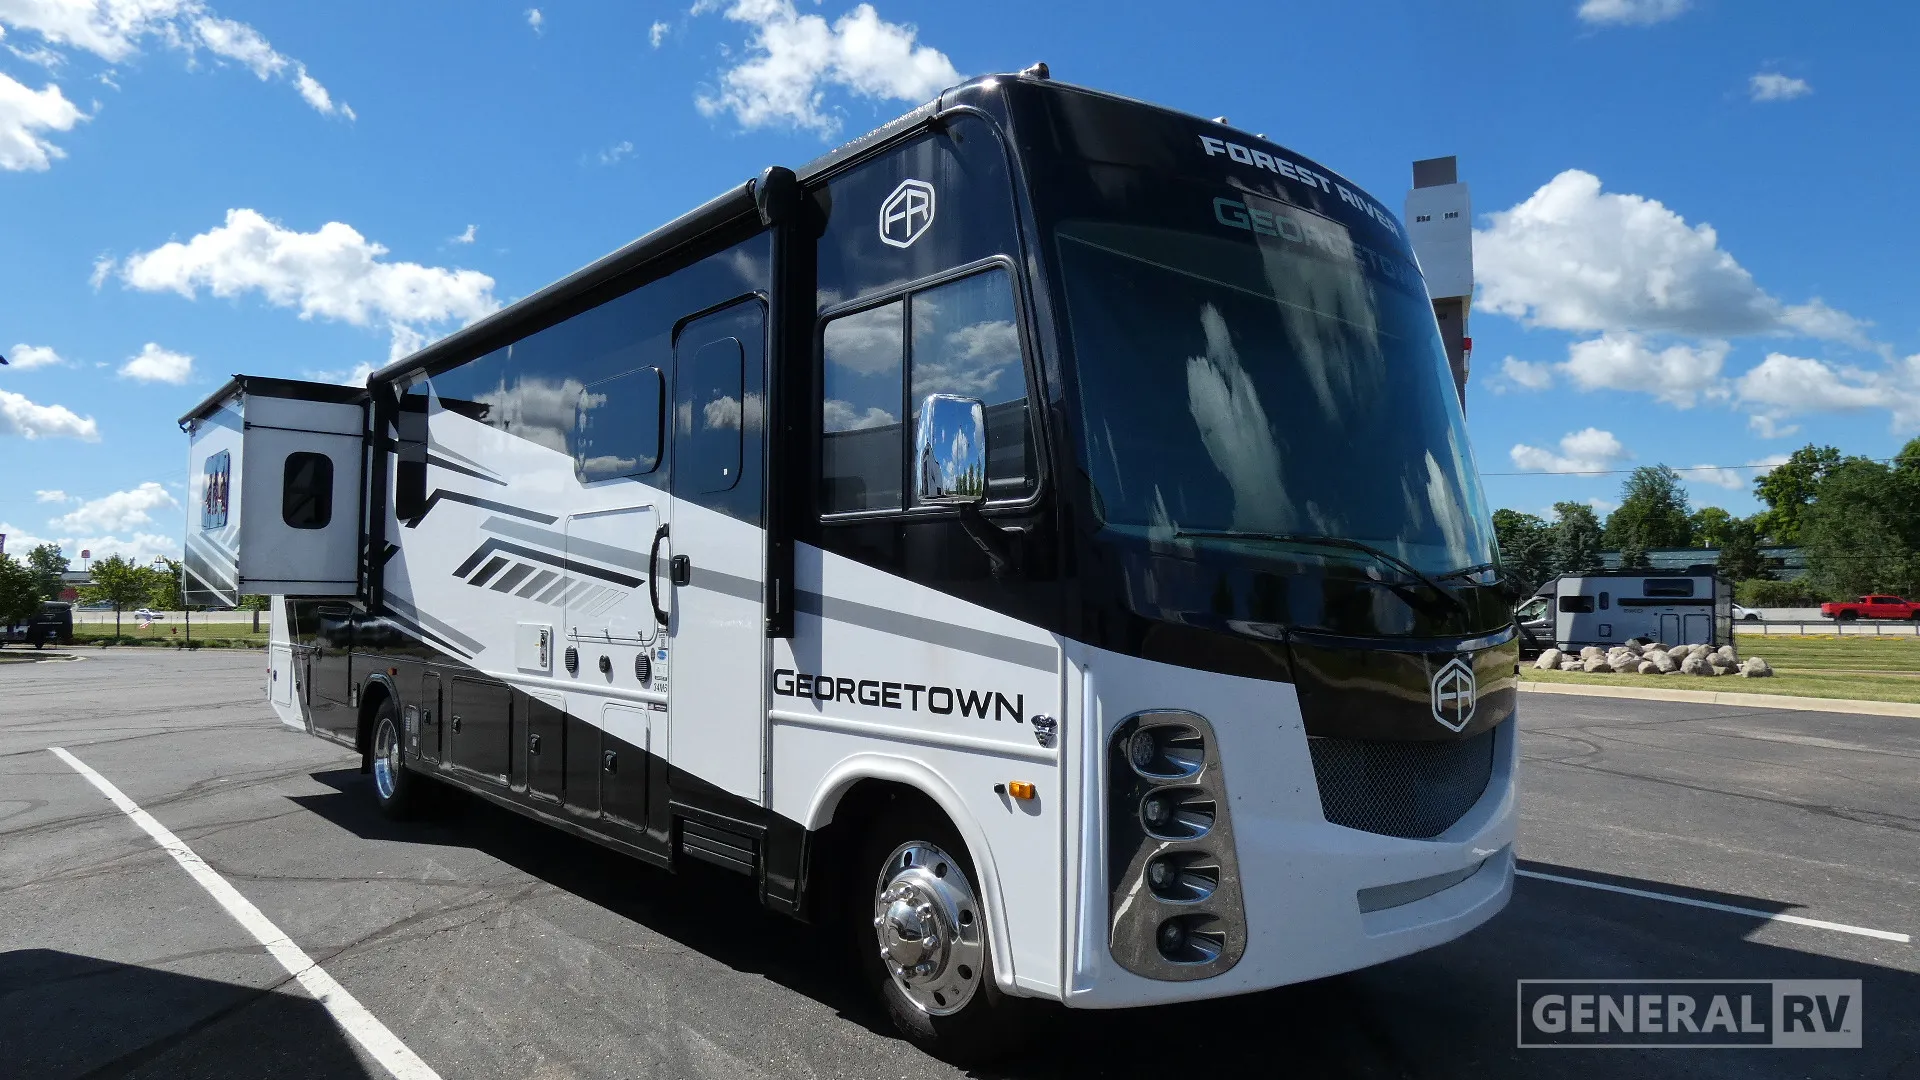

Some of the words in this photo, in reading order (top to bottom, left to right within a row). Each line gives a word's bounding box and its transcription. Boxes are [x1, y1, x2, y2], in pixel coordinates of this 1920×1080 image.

[1198, 134, 1330, 194] FOREST
[1334, 182, 1400, 240] RIVER
[1213, 196, 1410, 286] GEORGETO
[772, 668, 1025, 724] GEORGETOWN
